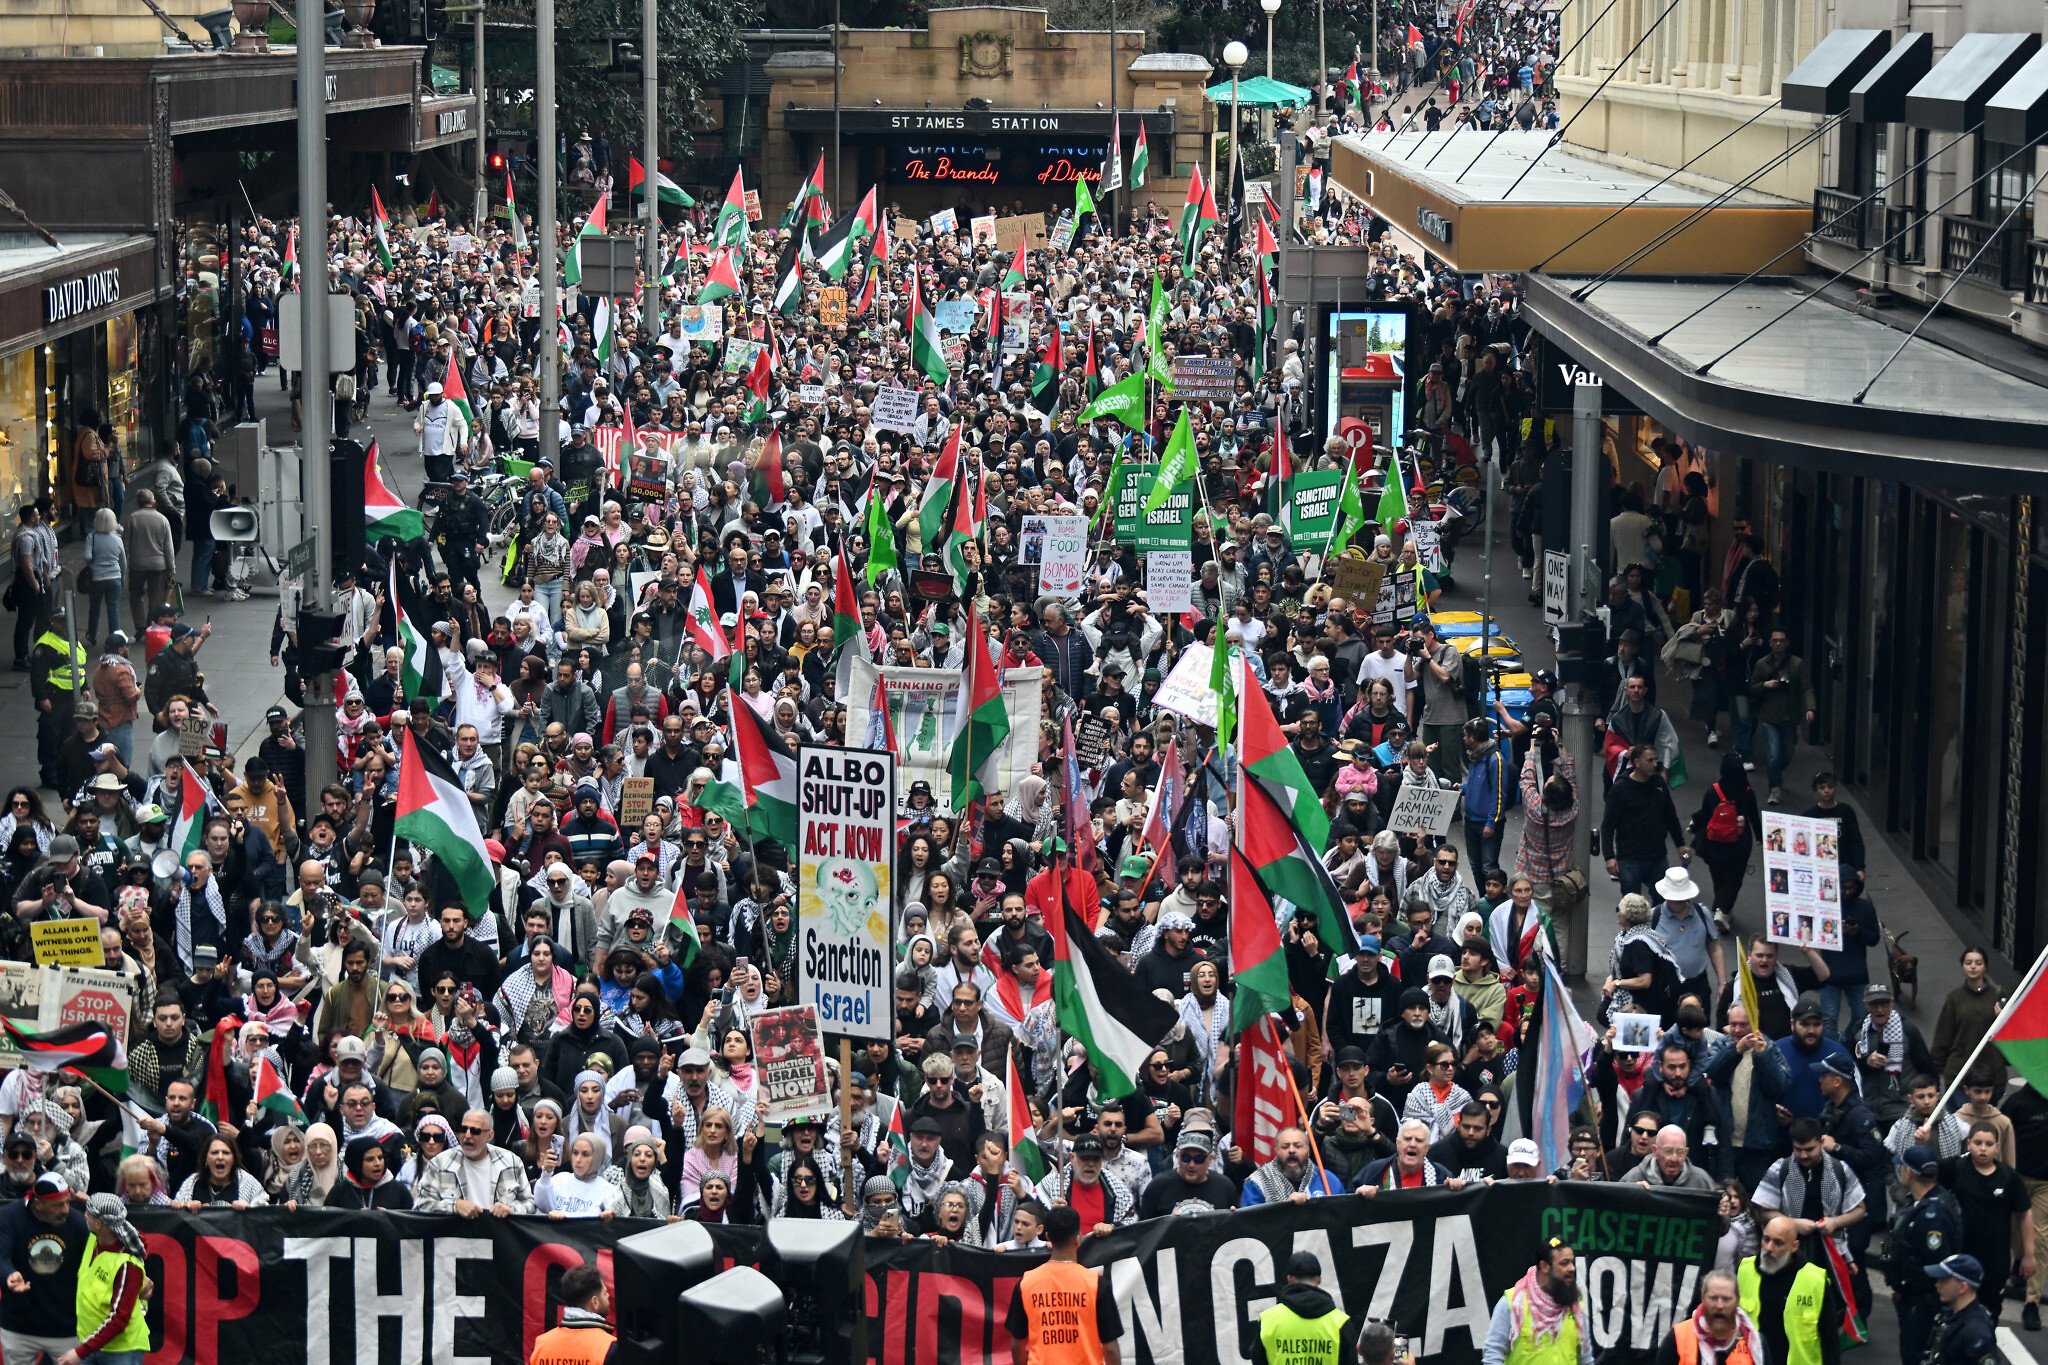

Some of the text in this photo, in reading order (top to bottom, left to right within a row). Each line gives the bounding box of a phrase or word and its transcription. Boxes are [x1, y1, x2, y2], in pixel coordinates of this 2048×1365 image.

[325, 75, 338, 101] NES
[891, 116, 1059, 129] ST JAMES STATION
[495, 129, 519, 137] Elizabeth
[905, 159, 931, 180] The
[935, 157, 999, 185] Brandy
[1037, 166, 1053, 185] of
[1052, 159, 1101, 181] Distin
[997, 220, 1042, 236] SANCTIONS
[49, 267, 120, 323] DAVID JONES
[820, 288, 845, 301] AID
[821, 312, 847, 324] BOMBS
[264, 337, 278, 345] GUC
[631, 479, 666, 493] MURDERING
[1140, 494, 1189, 510] SCTION
[1295, 484, 1337, 507] SANCTION
[1147, 509, 1182, 525] ISRAEL
[1300, 501, 1329, 520] ISRAEL
[1170, 538, 1188, 546] GREENS
[1293, 531, 1304, 541] VOTE
[1050, 539, 1079, 553] FOOD
[1044, 562, 1079, 578] BOMBS
[1341, 562, 1374, 577] Sanction
[1547, 559, 1564, 578] ONE
[1546, 580, 1565, 600] WAY
[1174, 674, 1199, 689] YOU
[1165, 682, 1192, 698] CAUSE
[1167, 694, 1179, 704] IT
[181, 718, 208, 734] STOP
[804, 755, 885, 786] ALBO
[627, 780, 649, 791] STOP
[623, 792, 653, 800] GENOCIDE
[802, 781, 886, 820] SHUT-UP
[1408, 789, 1440, 801] STOP
[626, 800, 648, 809] STOP
[1395, 802, 1443, 817] ARMING
[1394, 812, 1437, 831] ISRAEL
[804, 820, 884, 863] ACT. NOW
[43, 925, 89, 935] ALLAH IS A
[35, 935, 100, 948] WITNESS OVER
[42, 946, 94, 958] ALL THINGS.
[805, 927, 883, 990] Sanction
[66, 976, 130, 989] FREE PALESTIN
[76, 995, 114, 1012] STOP
[815, 984, 871, 1025] Israel
[61, 1008, 125, 1026] ISRAEL'S
[766, 1056, 813, 1072] SANCTION
[768, 1067, 815, 1084] ISRAEL
[769, 1078, 818, 1101] NOW
[1541, 1206, 1708, 1260] CEASEFIRE
[283, 1236, 494, 1365] THE
[1031, 1292, 1087, 1309] PALESTINE
[1576, 1254, 1700, 1350] OW
[1796, 1295, 1813, 1307] PAG
[1041, 1310, 1079, 1327] ACTION
[1042, 1328, 1079, 1346] GROUP
[1275, 1338, 1333, 1356] PALESTINE
